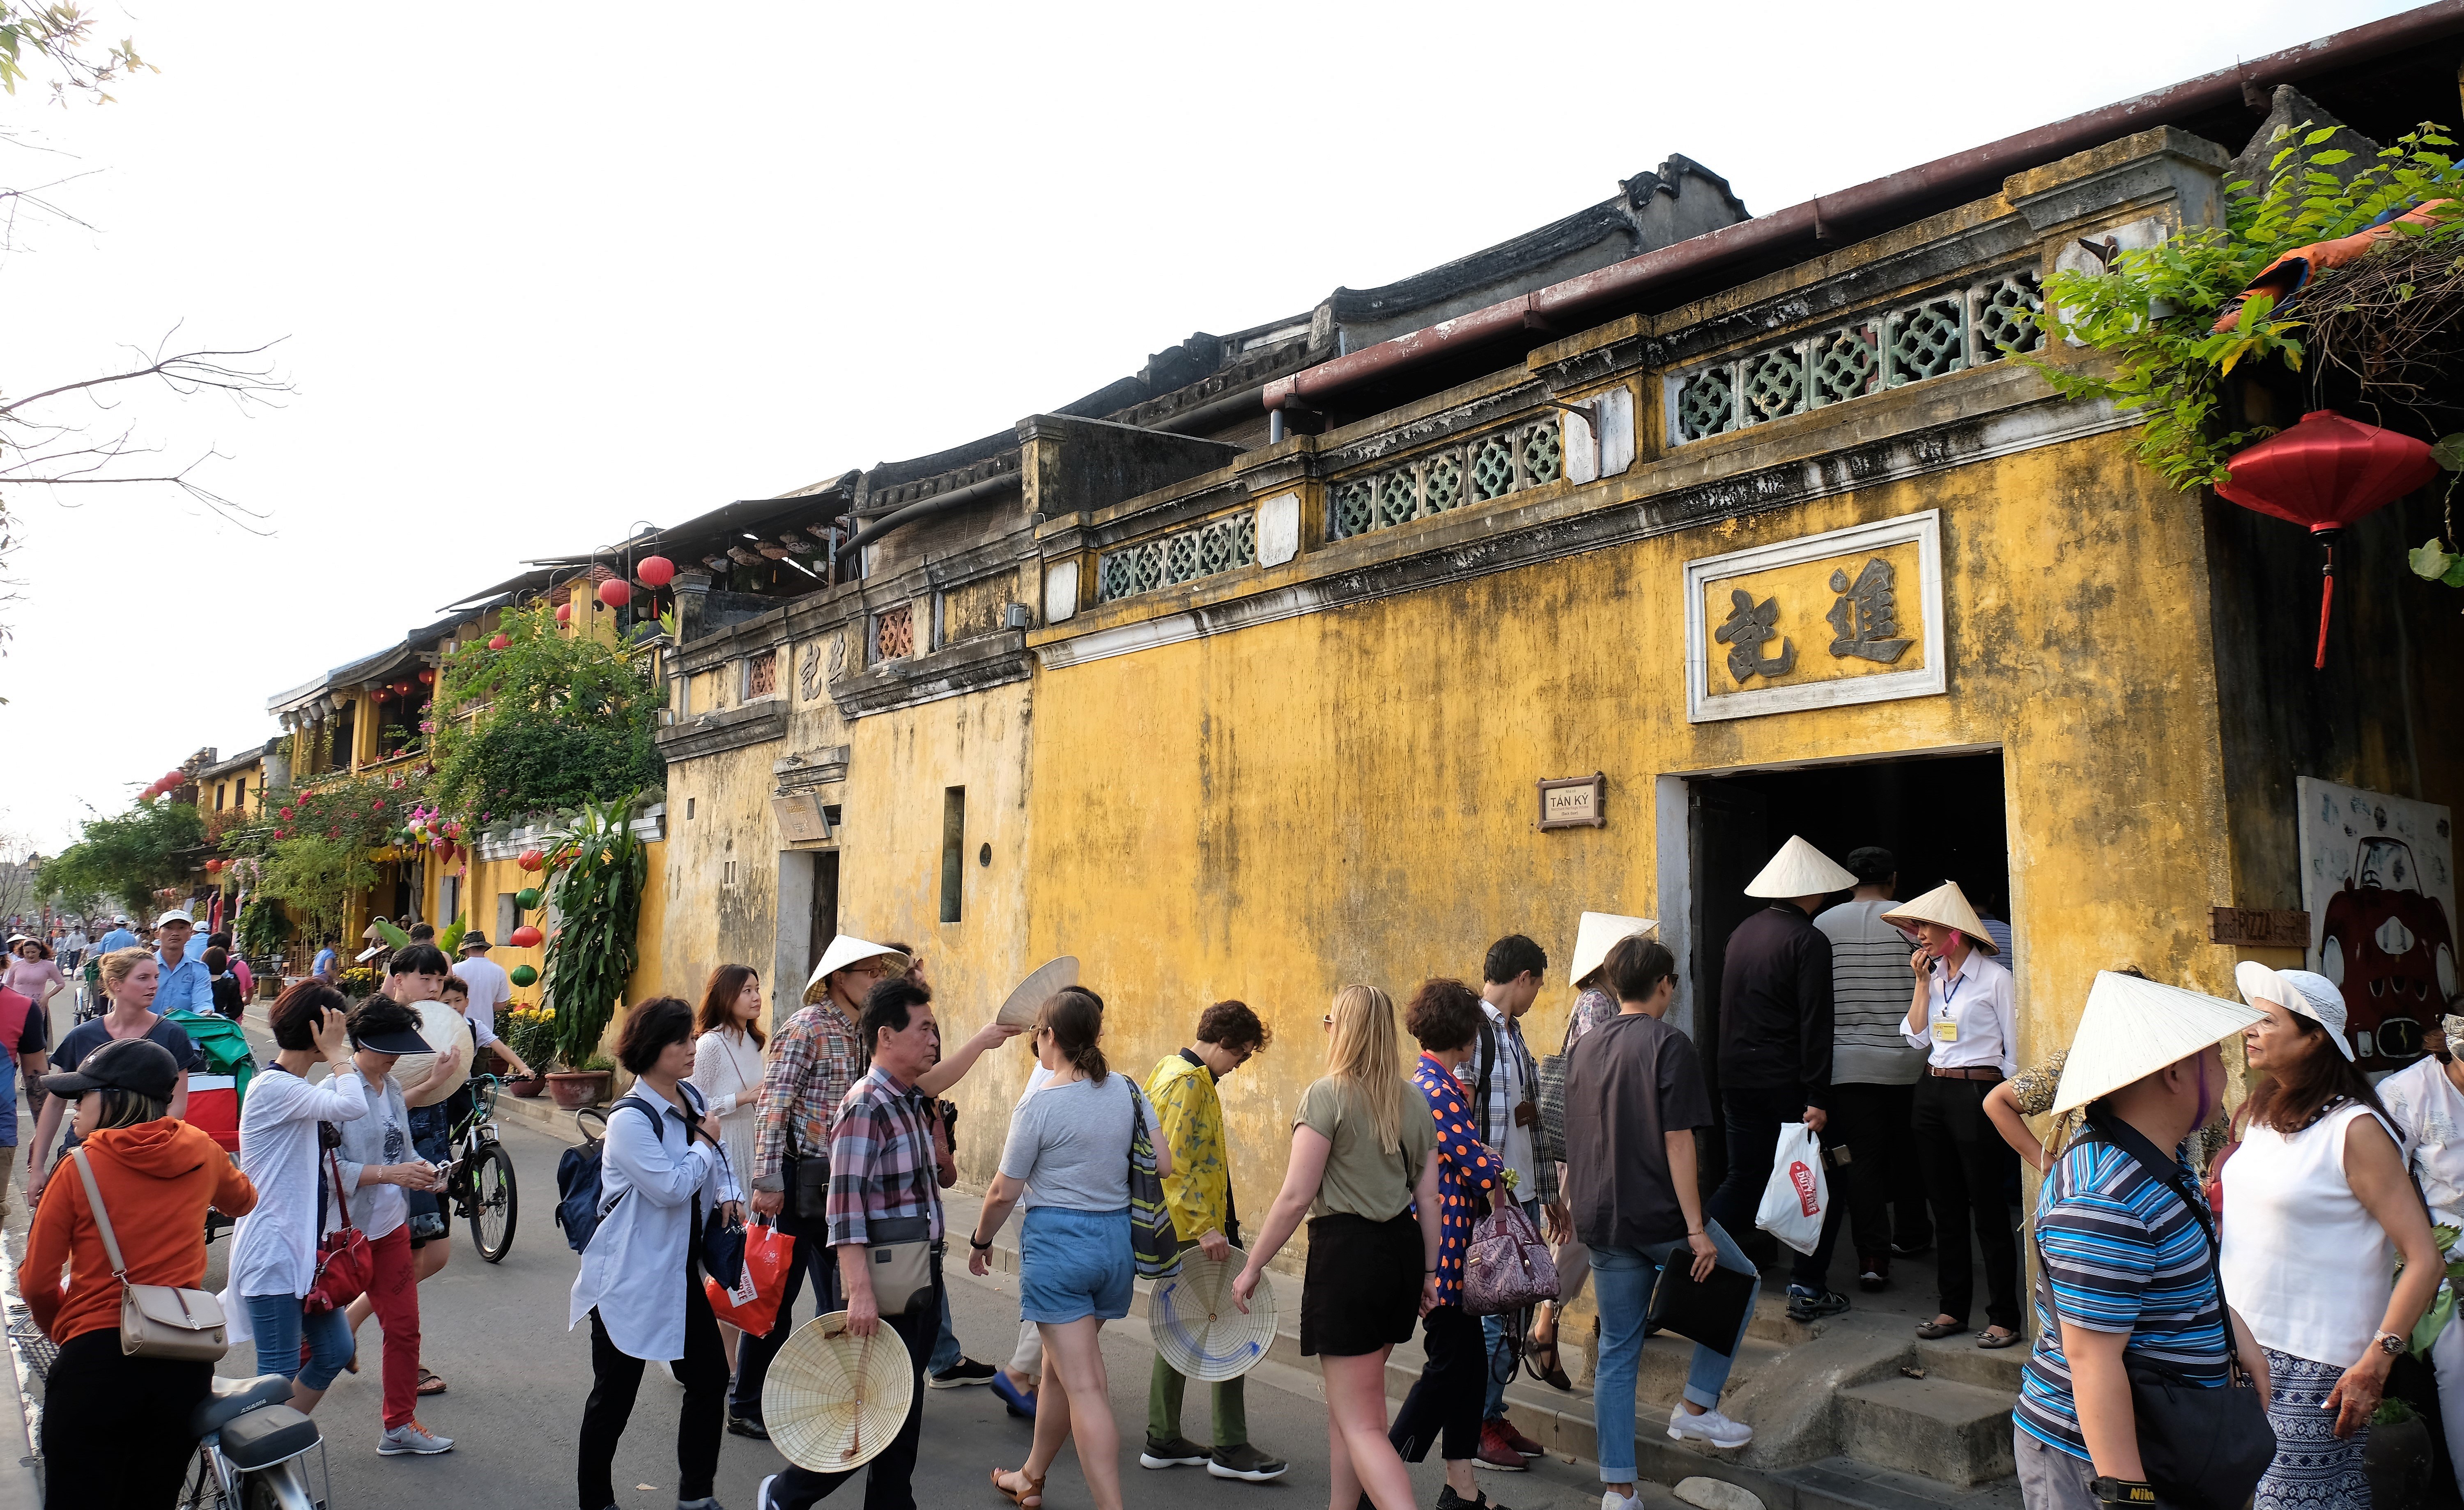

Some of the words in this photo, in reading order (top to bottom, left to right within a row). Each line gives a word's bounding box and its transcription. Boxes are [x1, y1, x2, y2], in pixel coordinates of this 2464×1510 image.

[1574, 792, 1589, 805] KÝ
[2238, 910, 2274, 940] PIZZA
[1797, 1171, 1813, 1192] DUTY
[1806, 1192, 1816, 1213] FREE
[737, 1279, 748, 1301] REE
[742, 1275, 754, 1297] AIRPORT
[240, 1398, 267, 1414] ASAMA
